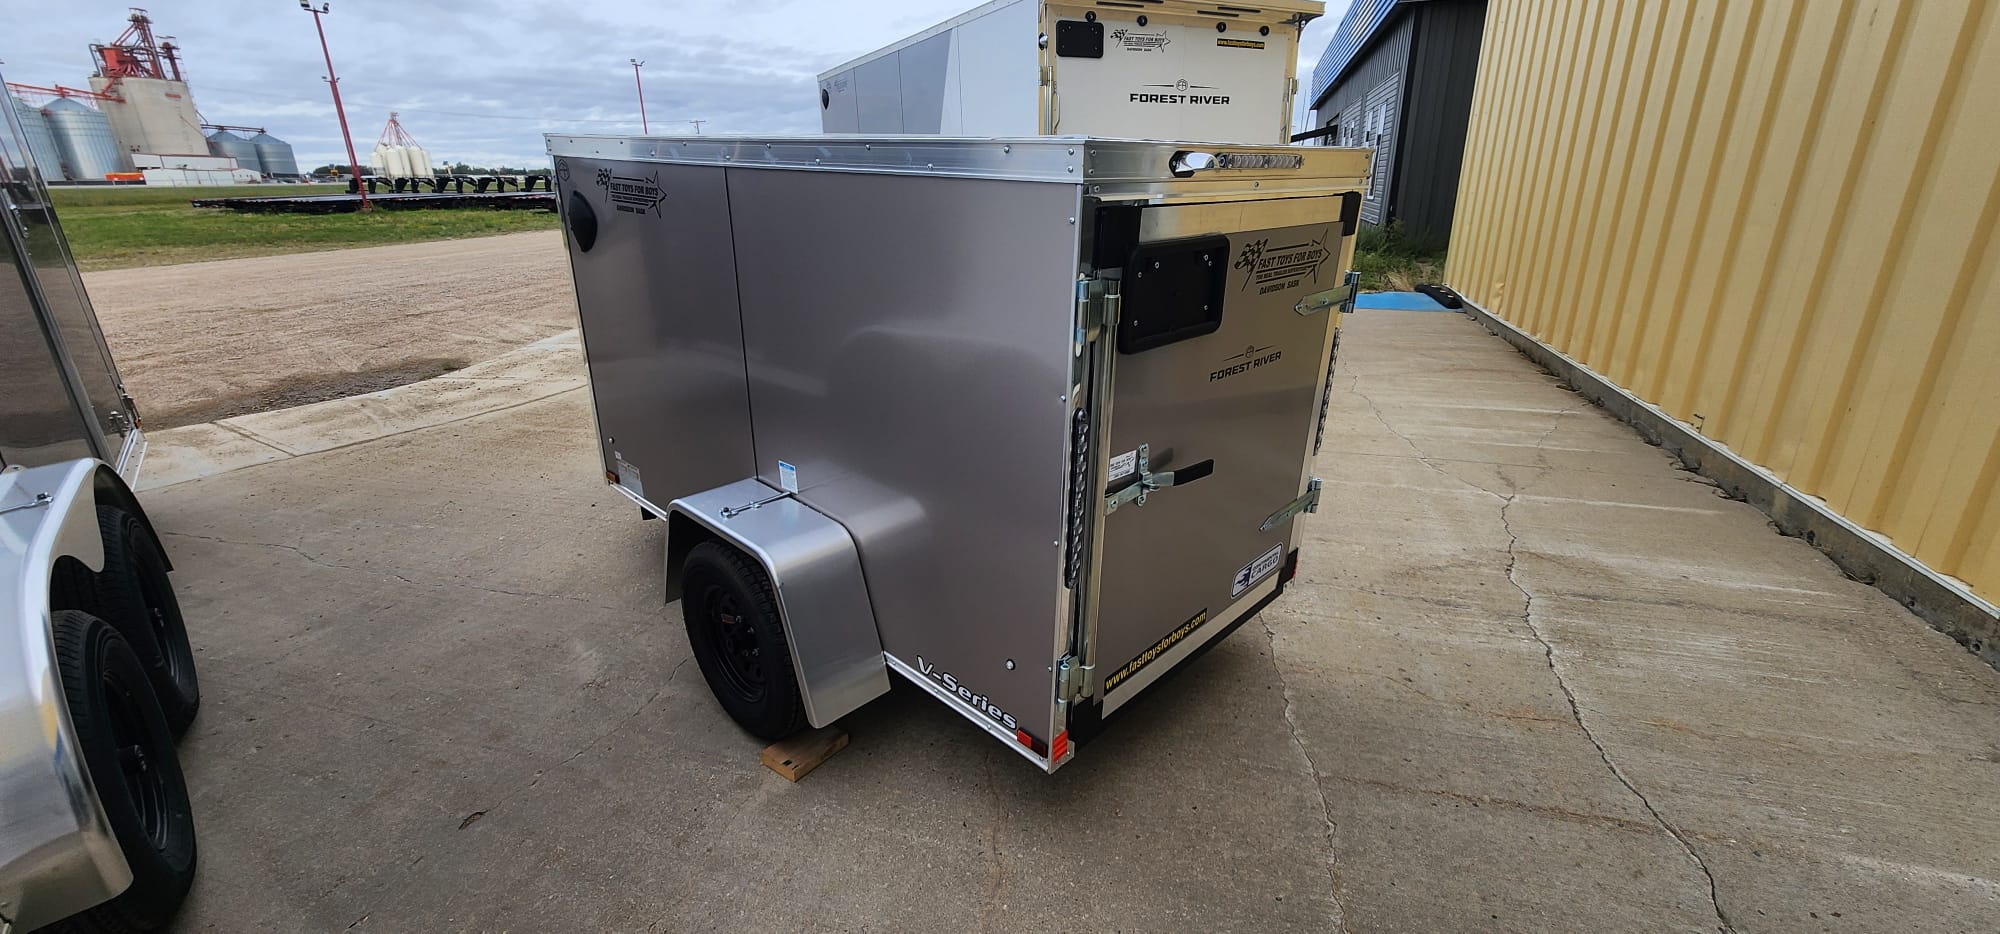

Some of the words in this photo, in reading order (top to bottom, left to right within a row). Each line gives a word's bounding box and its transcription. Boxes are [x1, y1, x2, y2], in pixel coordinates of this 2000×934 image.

[1130, 93, 1187, 104] FOREST
[1189, 95, 1230, 104] RIVER
[610, 182, 621, 191] FAST
[622, 183, 634, 193] TOYS
[634, 185, 645, 194] FOR
[645, 186, 659, 196] BOYS
[1258, 256, 1276, 269] FAST
[1277, 253, 1294, 266] TOYS
[1293, 251, 1307, 263] FOR
[1307, 248, 1323, 260] BOYS
[1209, 361, 1253, 382] FOREST
[1253, 351, 1282, 369] RIVER
[1251, 555, 1280, 579] CARGO
[1105, 611, 1206, 690] www.fasttoysforboys.com
[916, 654, 1017, 730] V-Series
